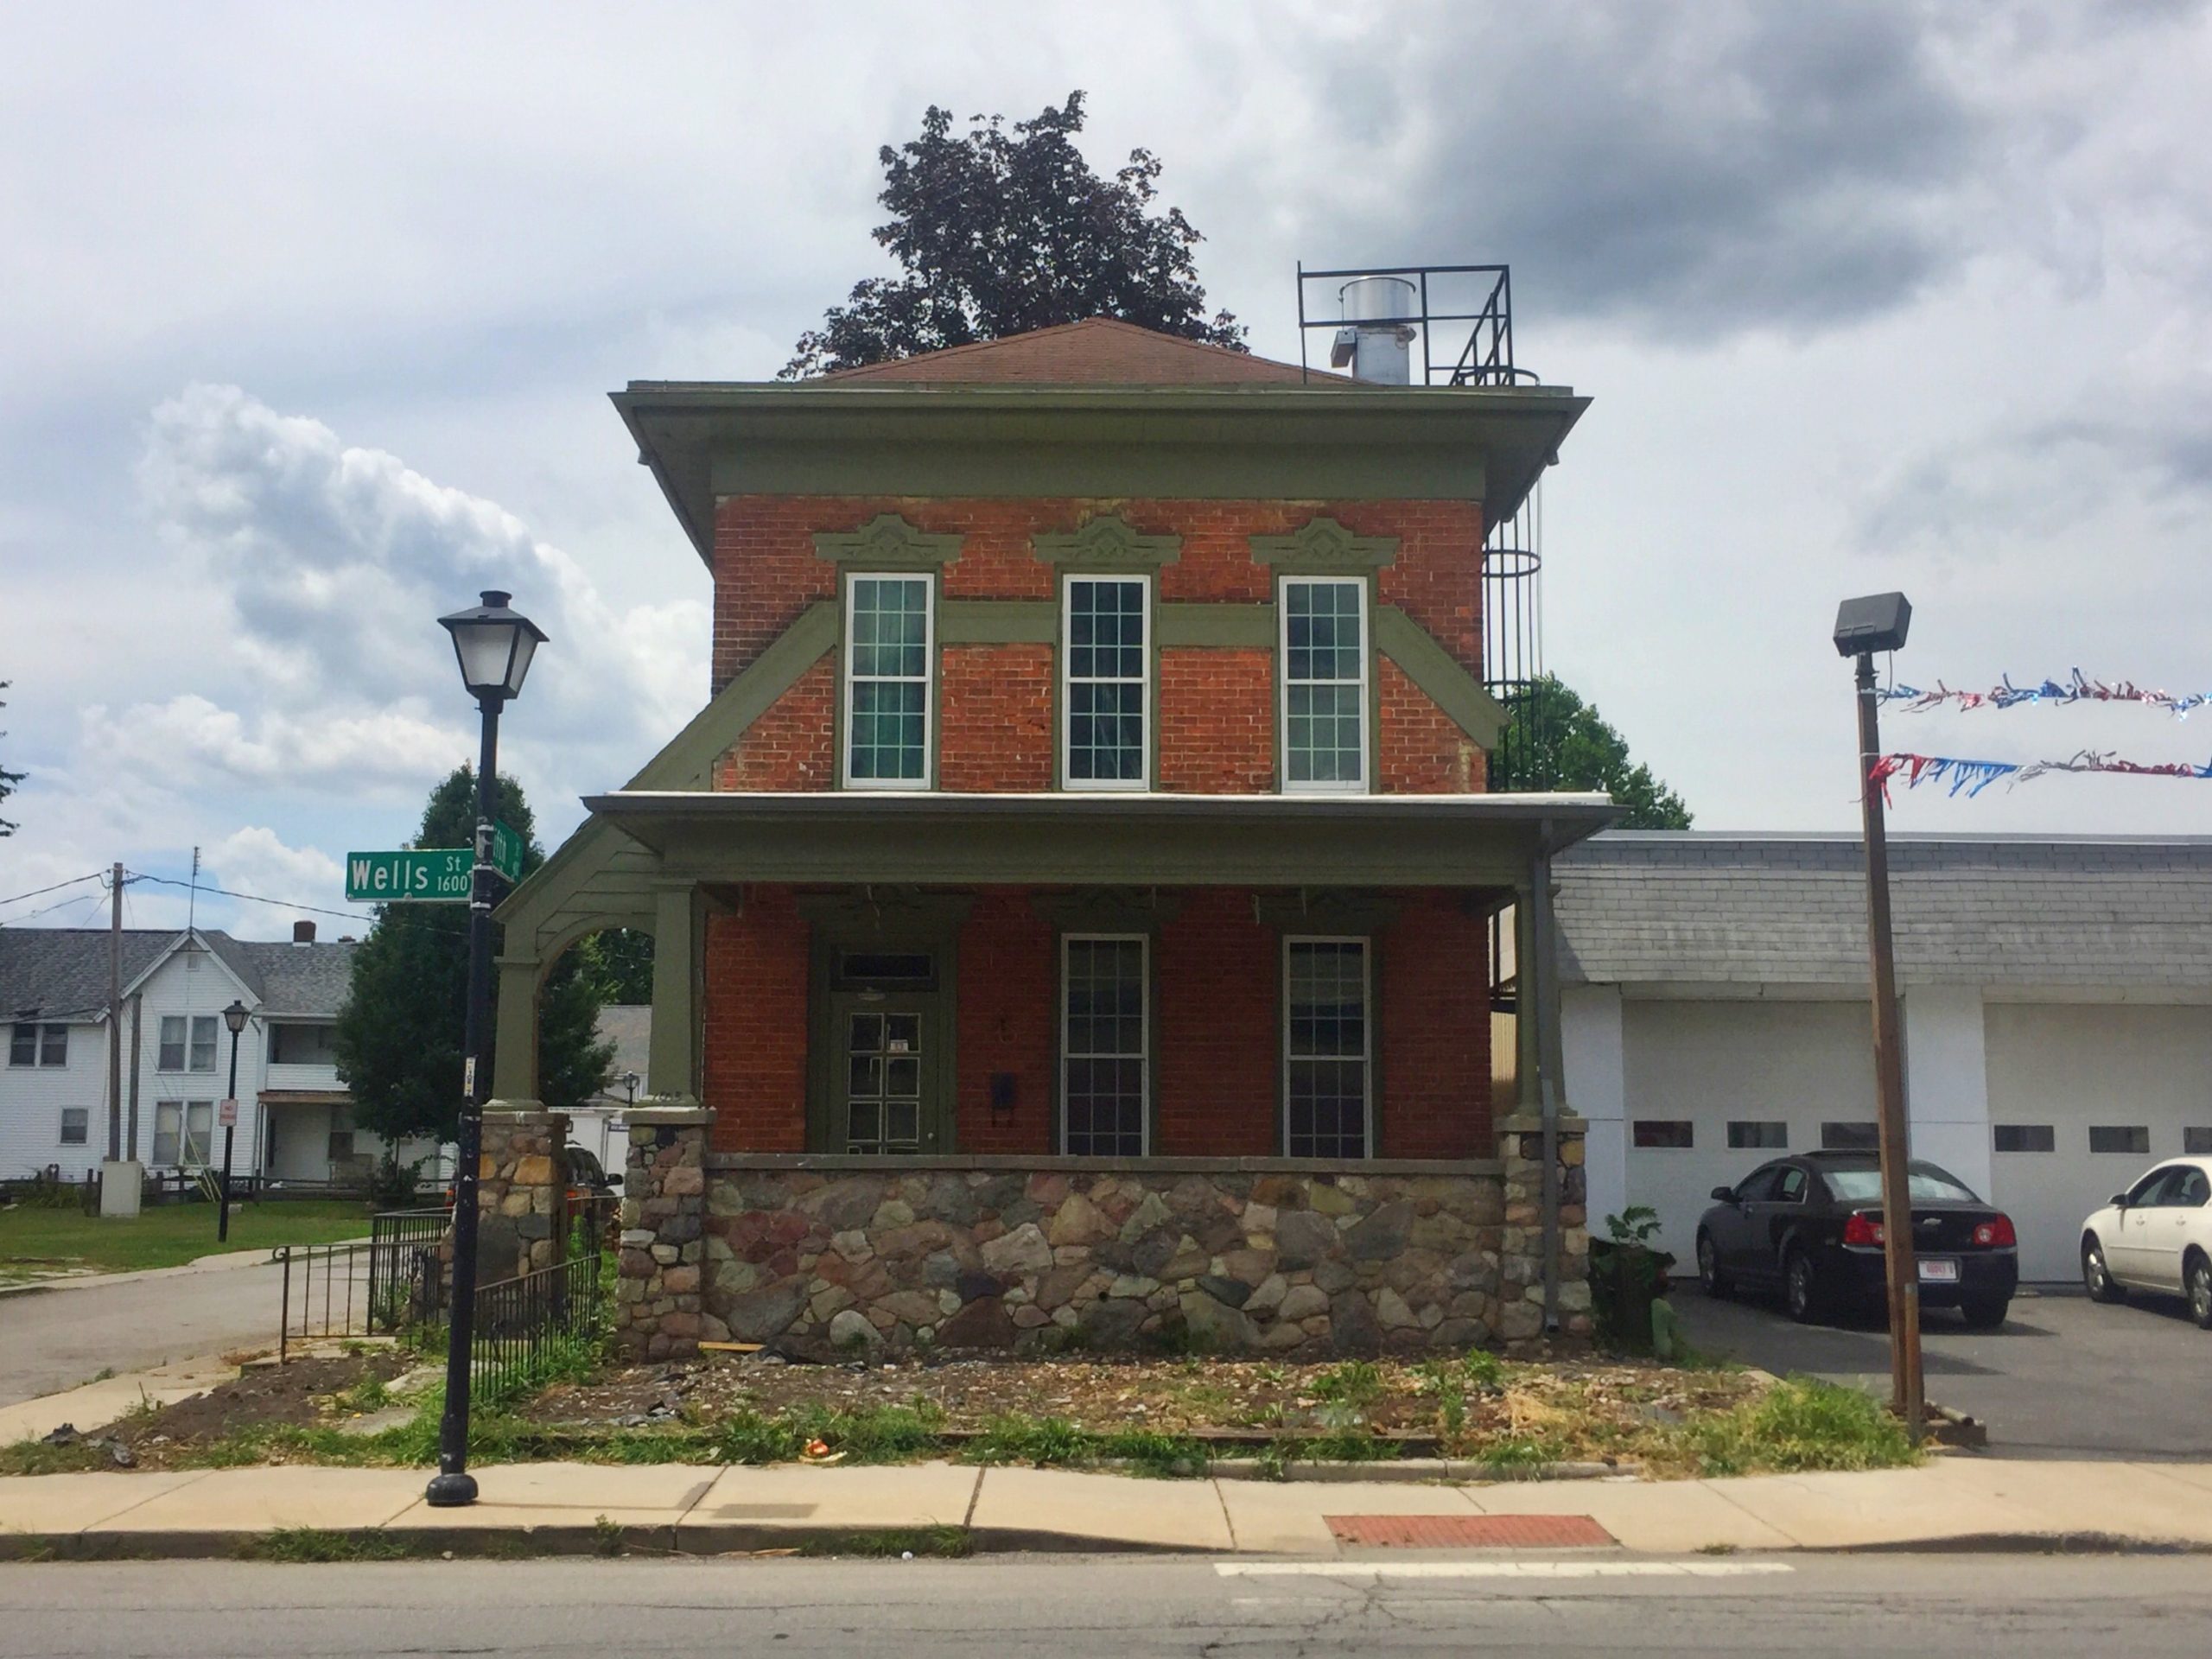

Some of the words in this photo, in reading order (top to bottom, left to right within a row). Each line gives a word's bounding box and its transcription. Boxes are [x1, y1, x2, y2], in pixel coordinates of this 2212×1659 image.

[352, 860, 429, 891] Wells
[446, 856, 461, 872] St
[437, 875, 468, 892] 1600
